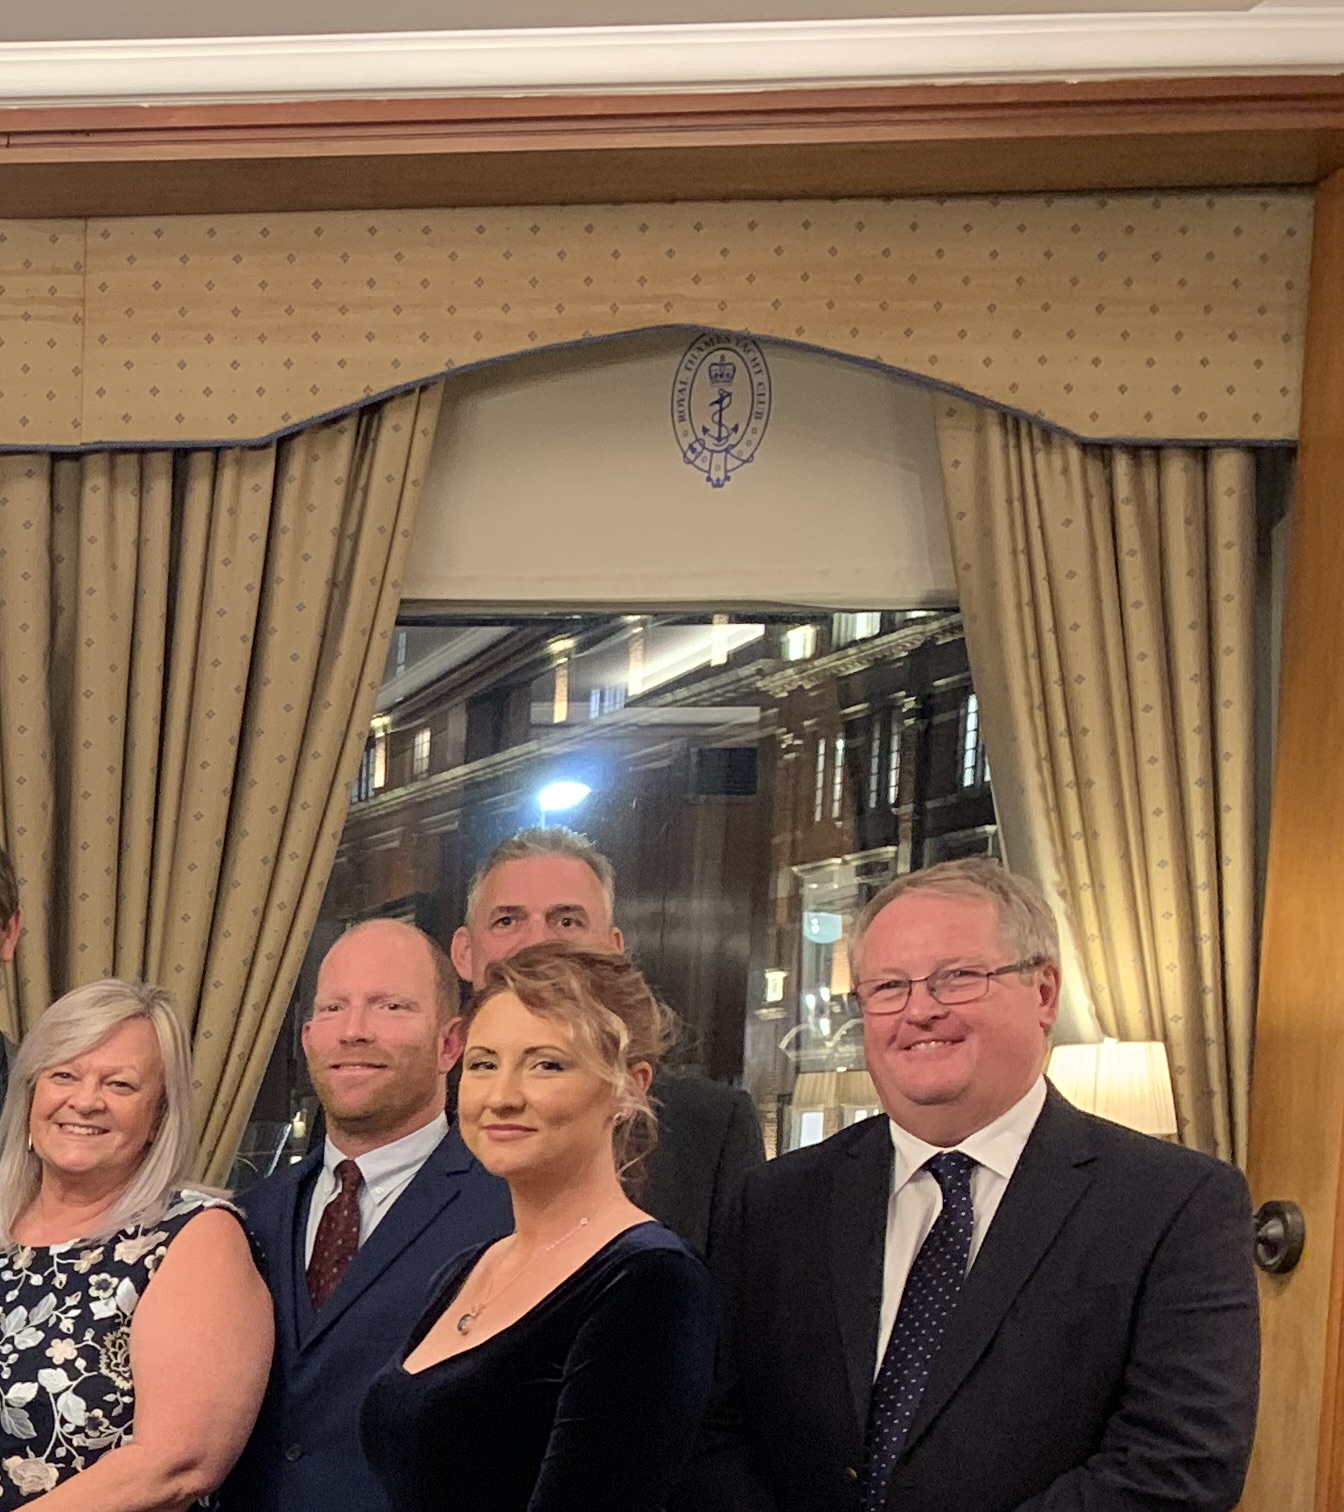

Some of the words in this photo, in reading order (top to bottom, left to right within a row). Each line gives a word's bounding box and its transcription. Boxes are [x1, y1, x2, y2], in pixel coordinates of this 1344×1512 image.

[676, 379, 688, 423] ROYAL
[684, 334, 731, 372] THAMES
[734, 336, 763, 375] YACHT
[755, 382, 766, 420] CLUB
